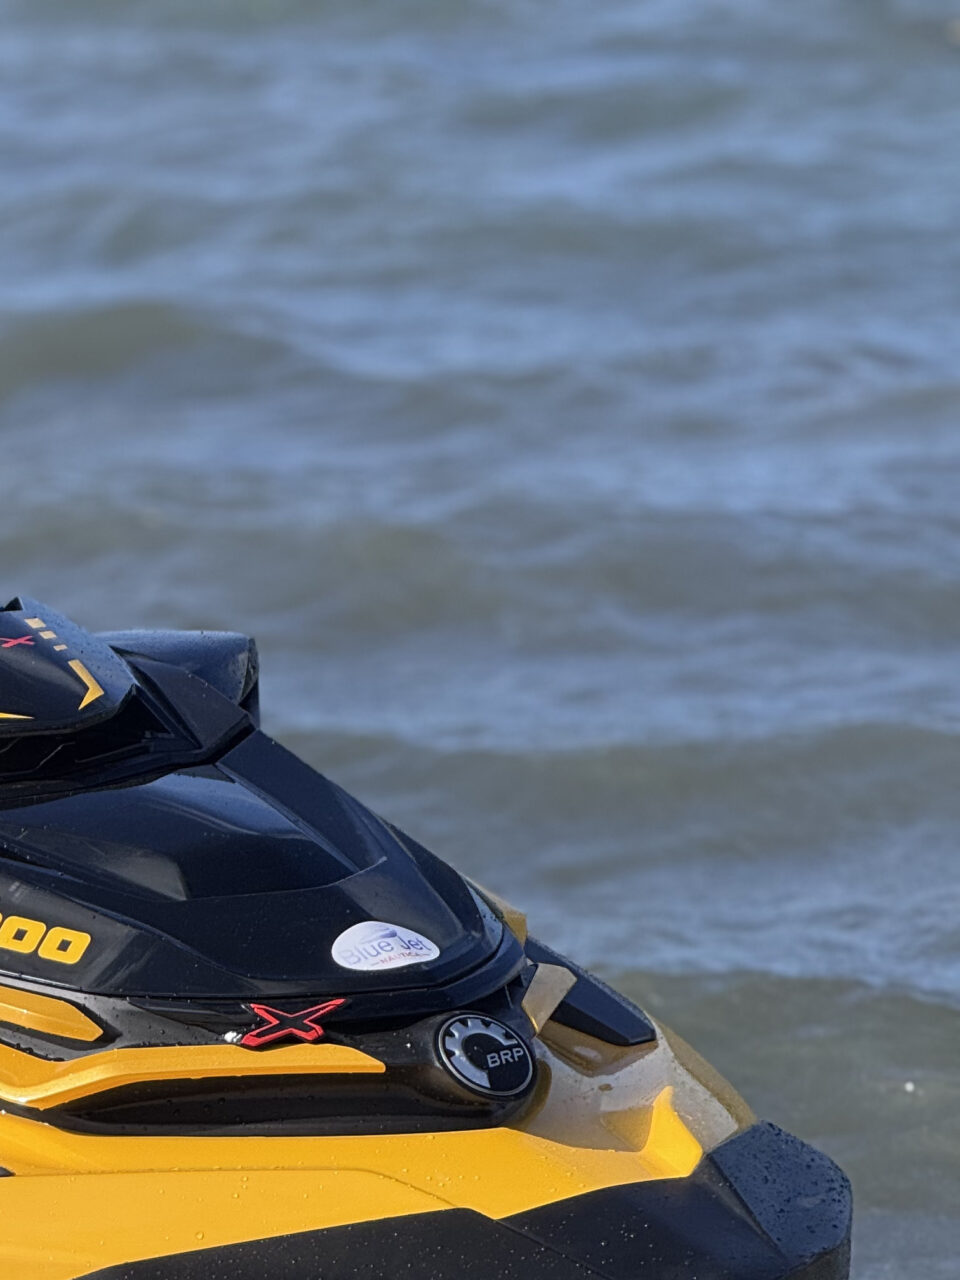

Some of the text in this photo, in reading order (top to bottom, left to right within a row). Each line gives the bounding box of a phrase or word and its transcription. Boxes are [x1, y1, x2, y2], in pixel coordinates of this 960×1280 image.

[341, 937, 432, 965] Blue Jet
[486, 1047, 524, 1068] BRP
